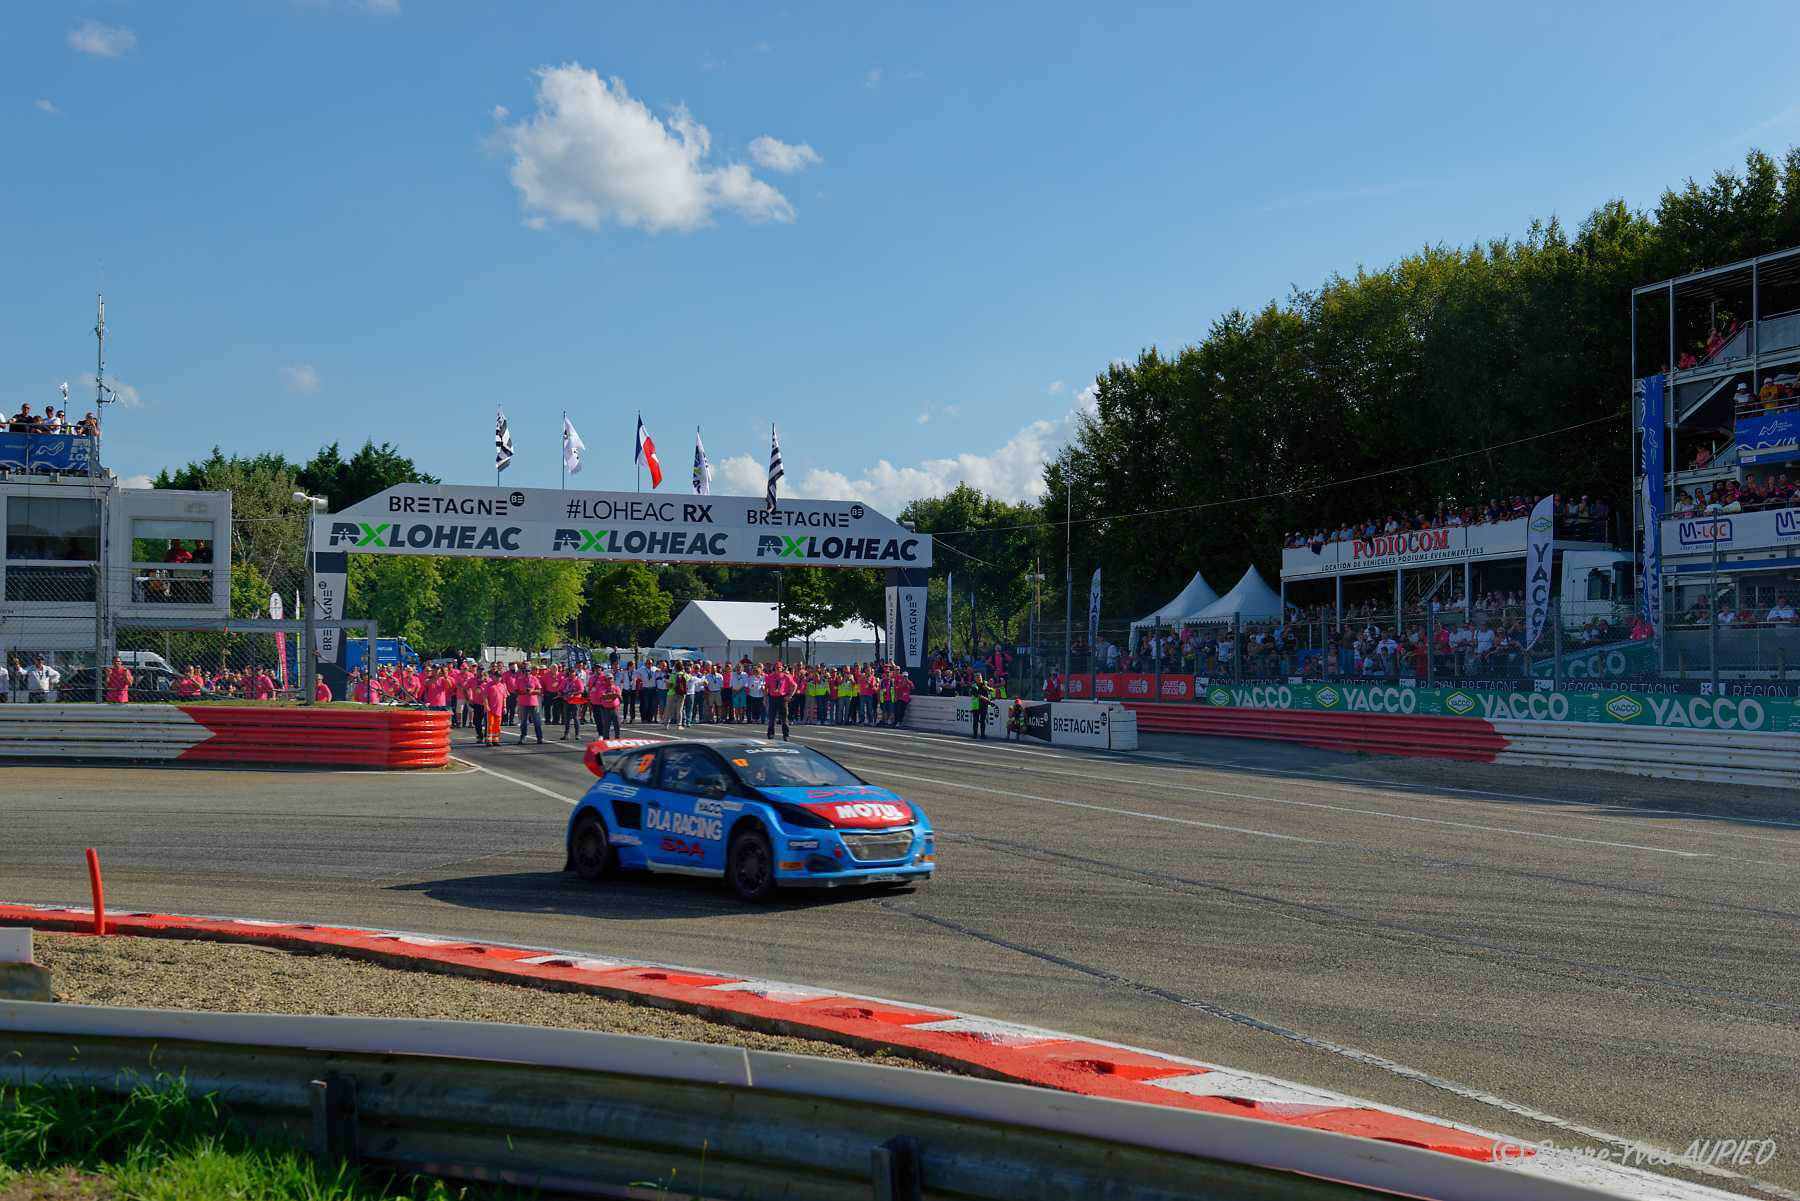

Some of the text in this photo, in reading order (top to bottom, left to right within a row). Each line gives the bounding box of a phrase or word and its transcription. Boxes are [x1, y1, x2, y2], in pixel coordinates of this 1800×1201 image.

[389, 496, 508, 516] BRETAGNE
[567, 499, 713, 523] #LOHEAC RX
[747, 508, 849, 528] BRETAGNE
[1680, 522, 1728, 539] M-LOC
[1352, 528, 1450, 560] PODIOCOM
[909, 600, 917, 656] BRETAGNE
[1231, 686, 1292, 709] YACCO
[1342, 687, 1416, 714] YACCO
[1475, 692, 1568, 721] YACCO
[1646, 697, 1765, 731] YACCO
[1053, 718, 1100, 735] BRETAGNE
[647, 806, 671, 832] DLA
[672, 812, 722, 841] RACING
[834, 803, 904, 821] MOTUL
